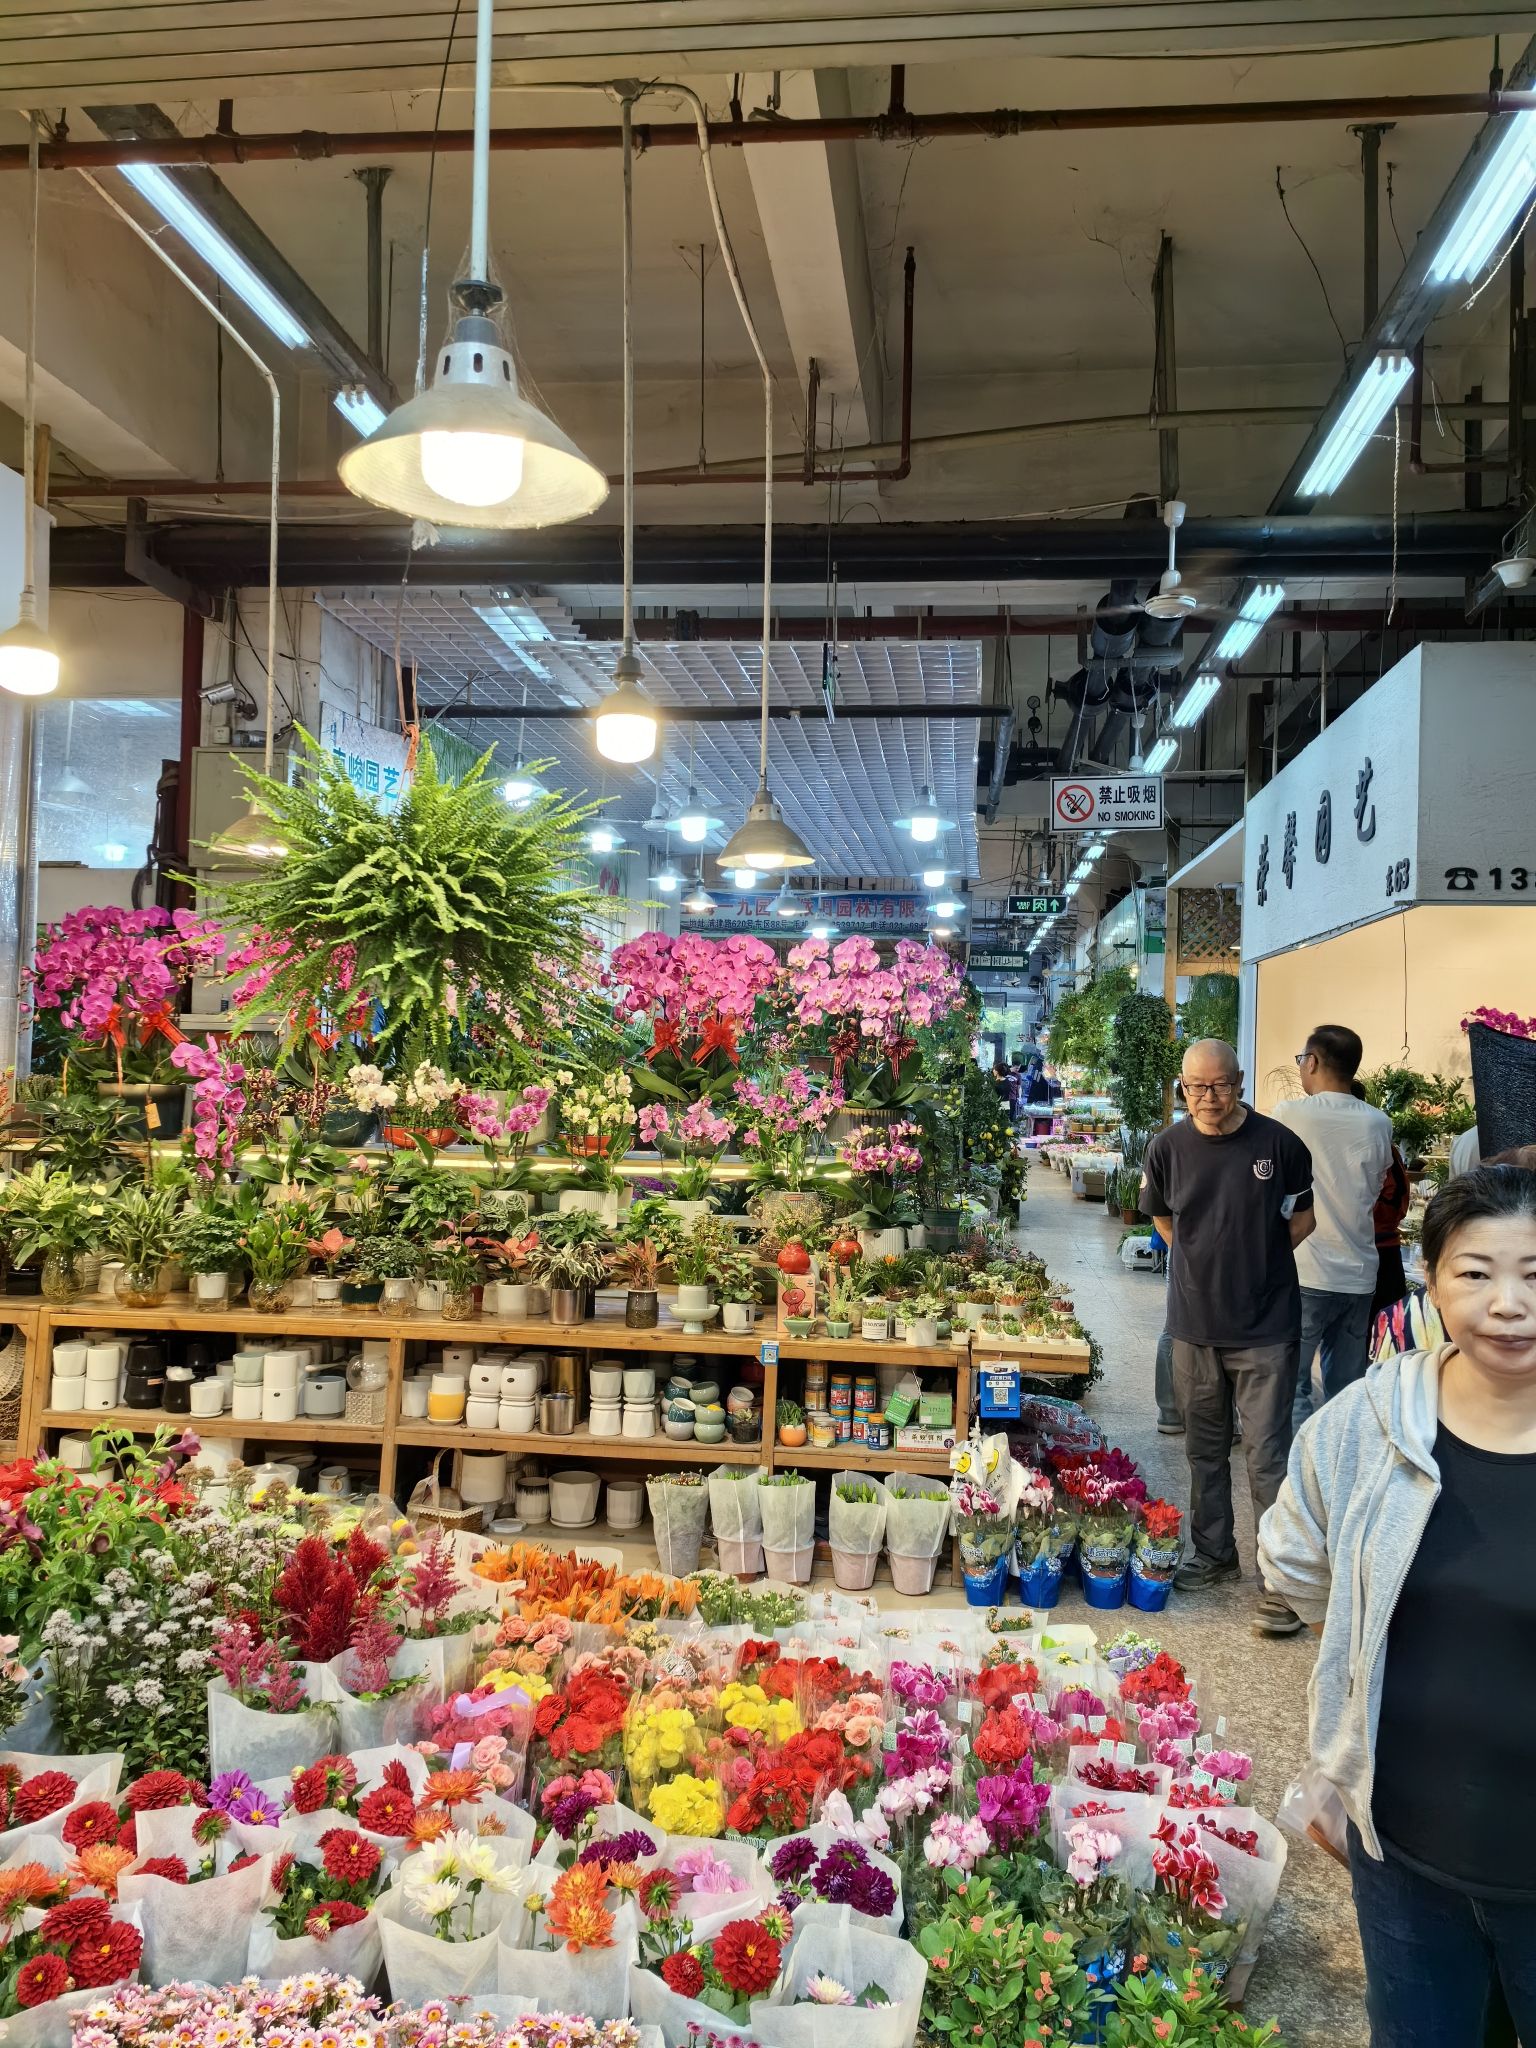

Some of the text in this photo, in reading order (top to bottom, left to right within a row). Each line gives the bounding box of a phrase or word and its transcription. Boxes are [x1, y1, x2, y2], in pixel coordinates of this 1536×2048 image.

[1099, 785, 1156, 805] 禁止吸烟
[1098, 810, 1155, 822] NO SMOKING
[1489, 867, 1536, 890] 13
